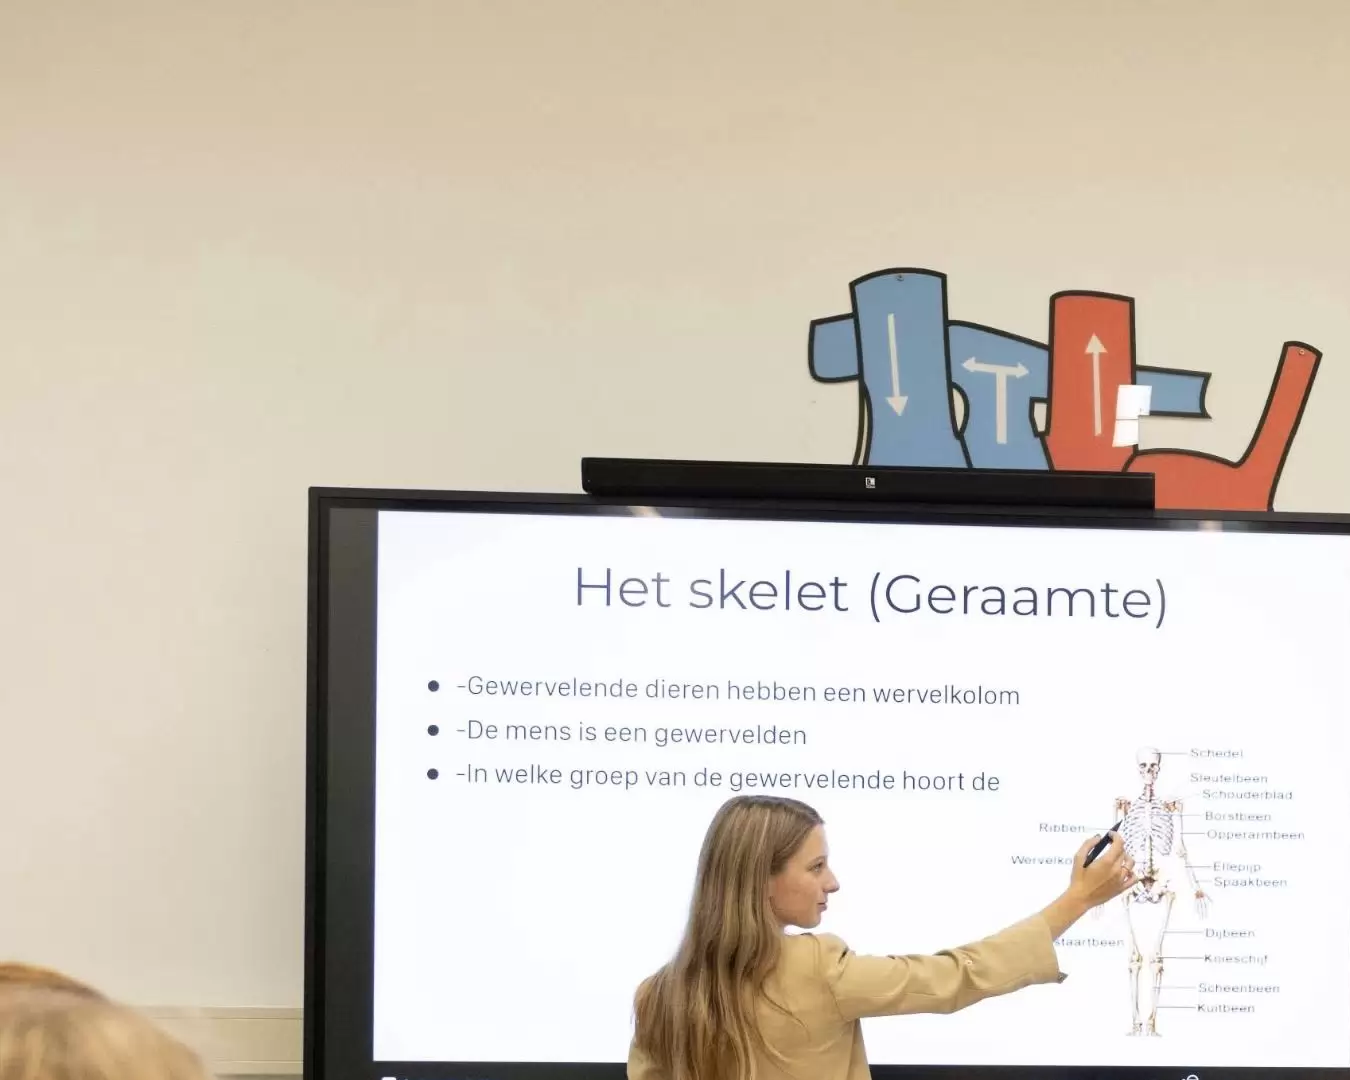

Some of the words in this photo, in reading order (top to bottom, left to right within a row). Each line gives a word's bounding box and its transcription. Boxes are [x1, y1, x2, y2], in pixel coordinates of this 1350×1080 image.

[576, 567, 671, 607] Het
[688, 568, 849, 612] skelet
[869, 572, 1167, 629] (Geraamte)
[456, 675, 638, 698] -Gewervelende
[645, 678, 720, 700] dieren
[727, 680, 816, 702] hebben
[823, 686, 866, 703] een
[872, 685, 1020, 705] wervelkolom
[456, 719, 498, 740] -De
[506, 724, 572, 741] mens
[579, 722, 597, 742] is
[604, 726, 647, 743] een
[654, 724, 807, 747] gewervelden
[1190, 748, 1244, 758] Schedel
[456, 764, 488, 784] -In
[494, 764, 563, 785] welke
[570, 769, 639, 790] groep
[645, 770, 686, 787] van
[694, 768, 722, 787] de
[729, 769, 896, 792] gewervelende
[903, 770, 965, 791] hoort
[972, 772, 1000, 791] de
[1190, 772, 1268, 783] Sleutelbeen
[1202, 788, 1293, 800] Schouderblad
[1205, 810, 1271, 821] Borstbeen
[1039, 822, 1085, 833] Ribben
[1207, 829, 1305, 840] Opperarmbeen
[1011, 855, 1073, 865] Wervelko
[1213, 860, 1261, 873] Ellepijp
[1214, 876, 1287, 888] Spaakbeen
[1205, 927, 1255, 939] Dijbeen
[1204, 953, 1268, 966] Knieschijf
[1198, 982, 1280, 993] Scheenbeen
[1197, 1003, 1256, 1013] Kuitbeen
